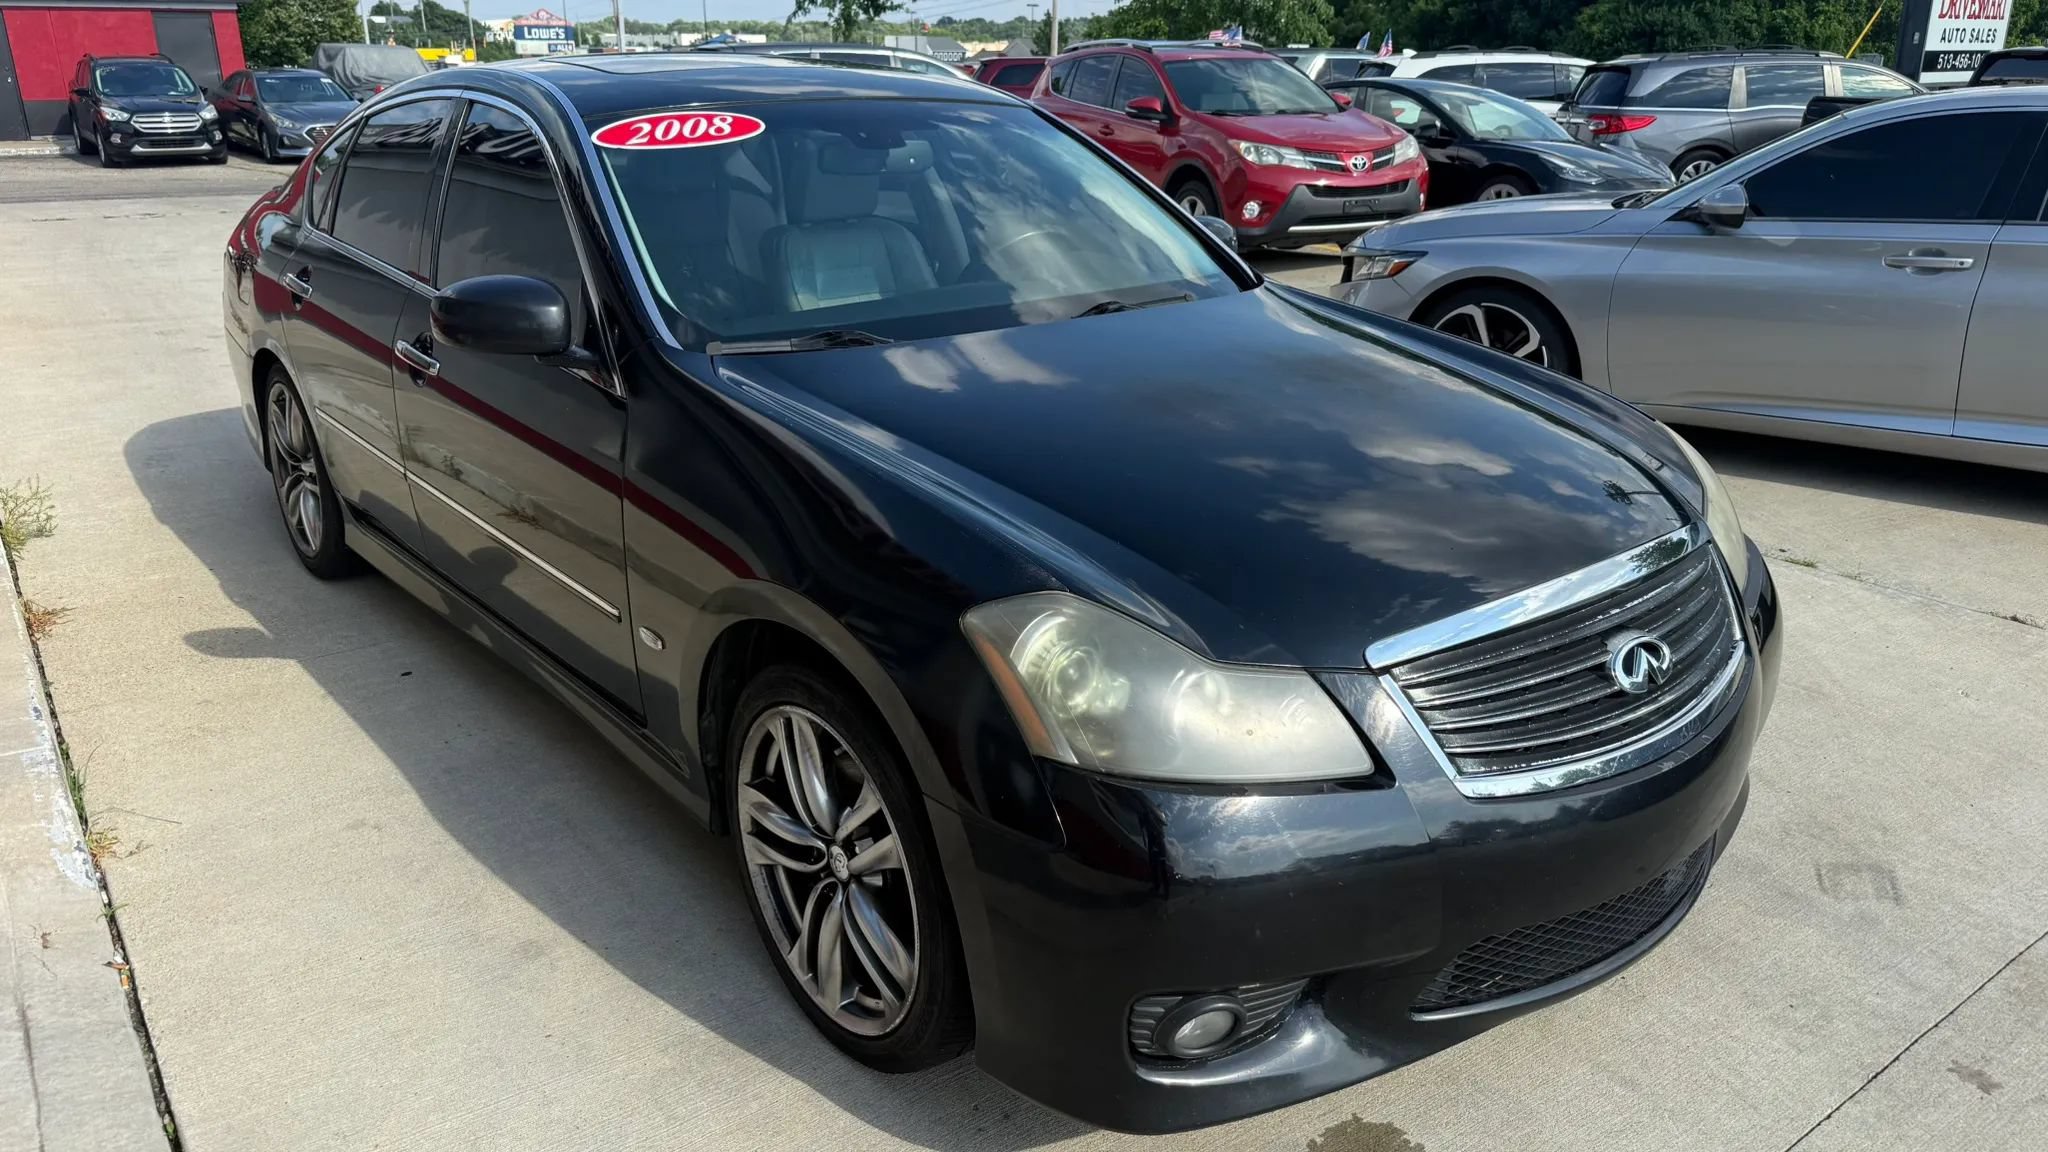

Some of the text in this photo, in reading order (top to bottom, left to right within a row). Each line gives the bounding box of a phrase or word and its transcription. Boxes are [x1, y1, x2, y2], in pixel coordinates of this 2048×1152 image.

[523, 26, 566, 39] LOWE'S
[1940, 28, 1997, 43] AUTO SALES
[625, 115, 734, 146] 2008
